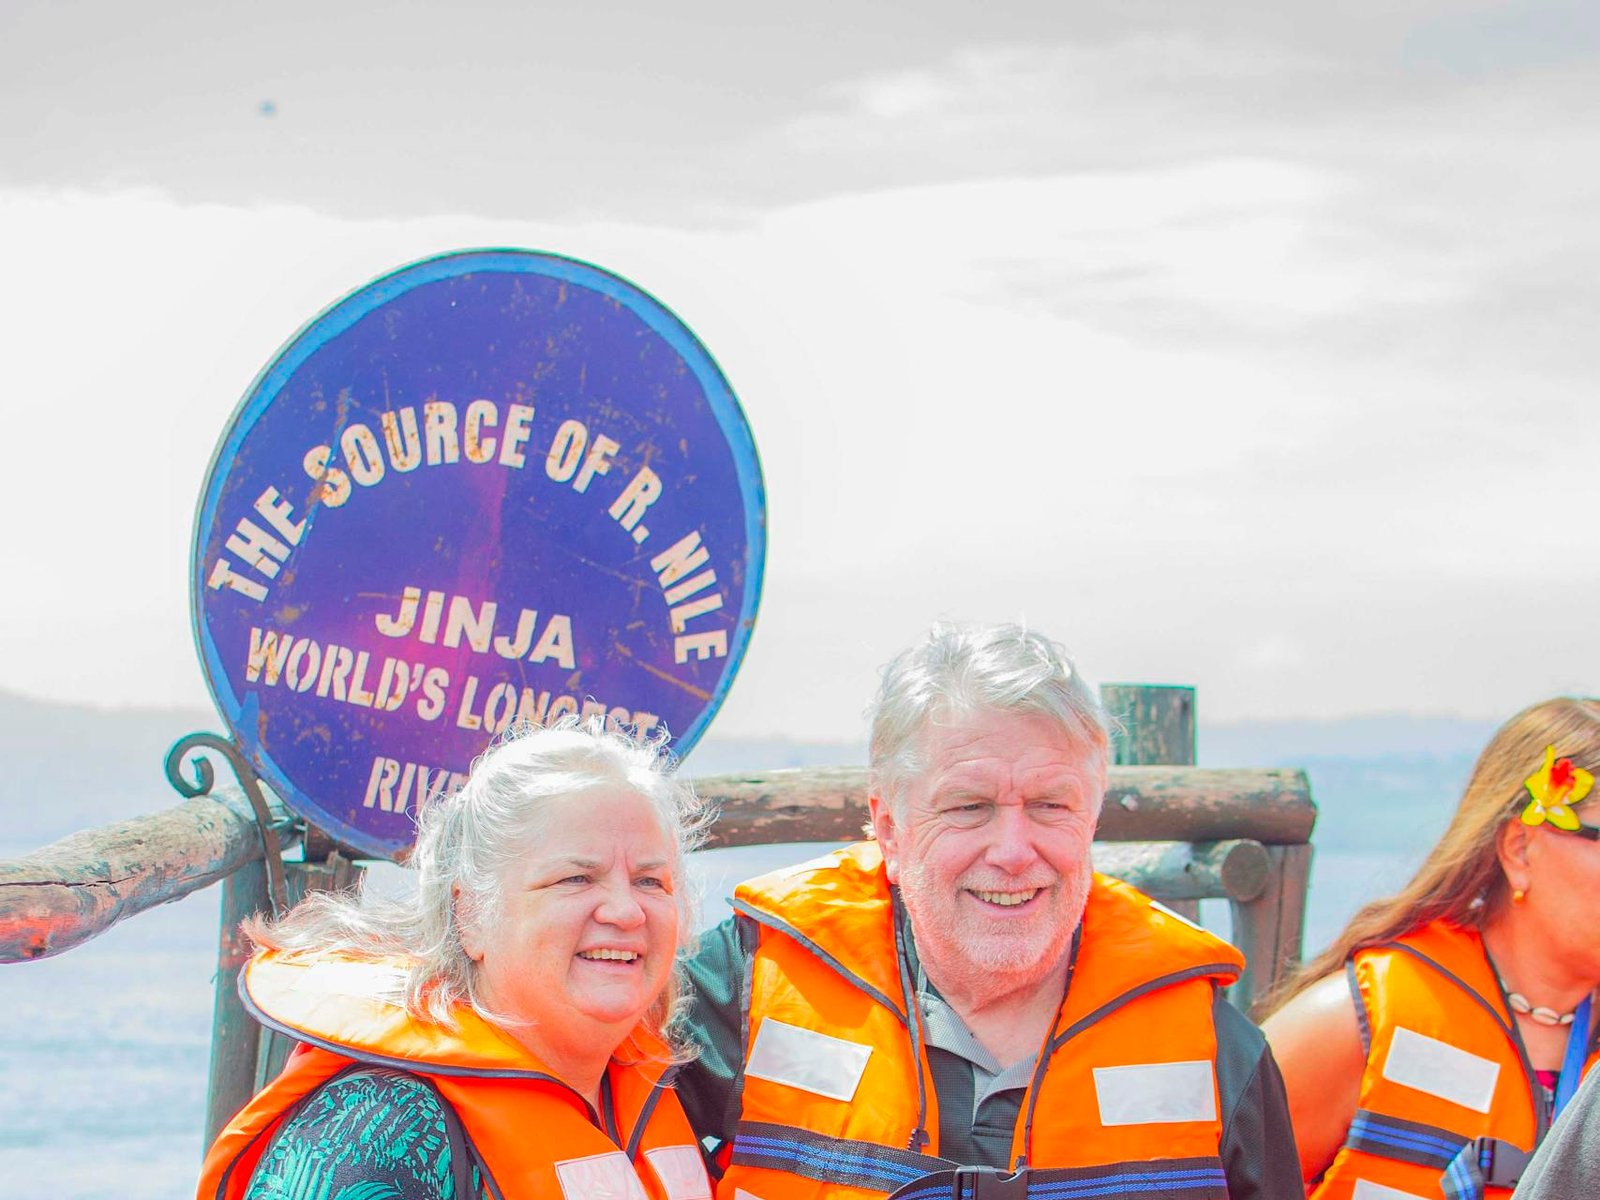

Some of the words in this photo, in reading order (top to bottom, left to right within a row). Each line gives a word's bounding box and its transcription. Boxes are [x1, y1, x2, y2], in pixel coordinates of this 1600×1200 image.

[208, 486, 307, 602] THE
[303, 400, 535, 508] SOURCE
[545, 419, 620, 494] OF
[609, 466, 663, 544] R.
[650, 531, 727, 664] NILE
[245, 627, 449, 721] WORLD'S
[375, 586, 576, 670] JINJA
